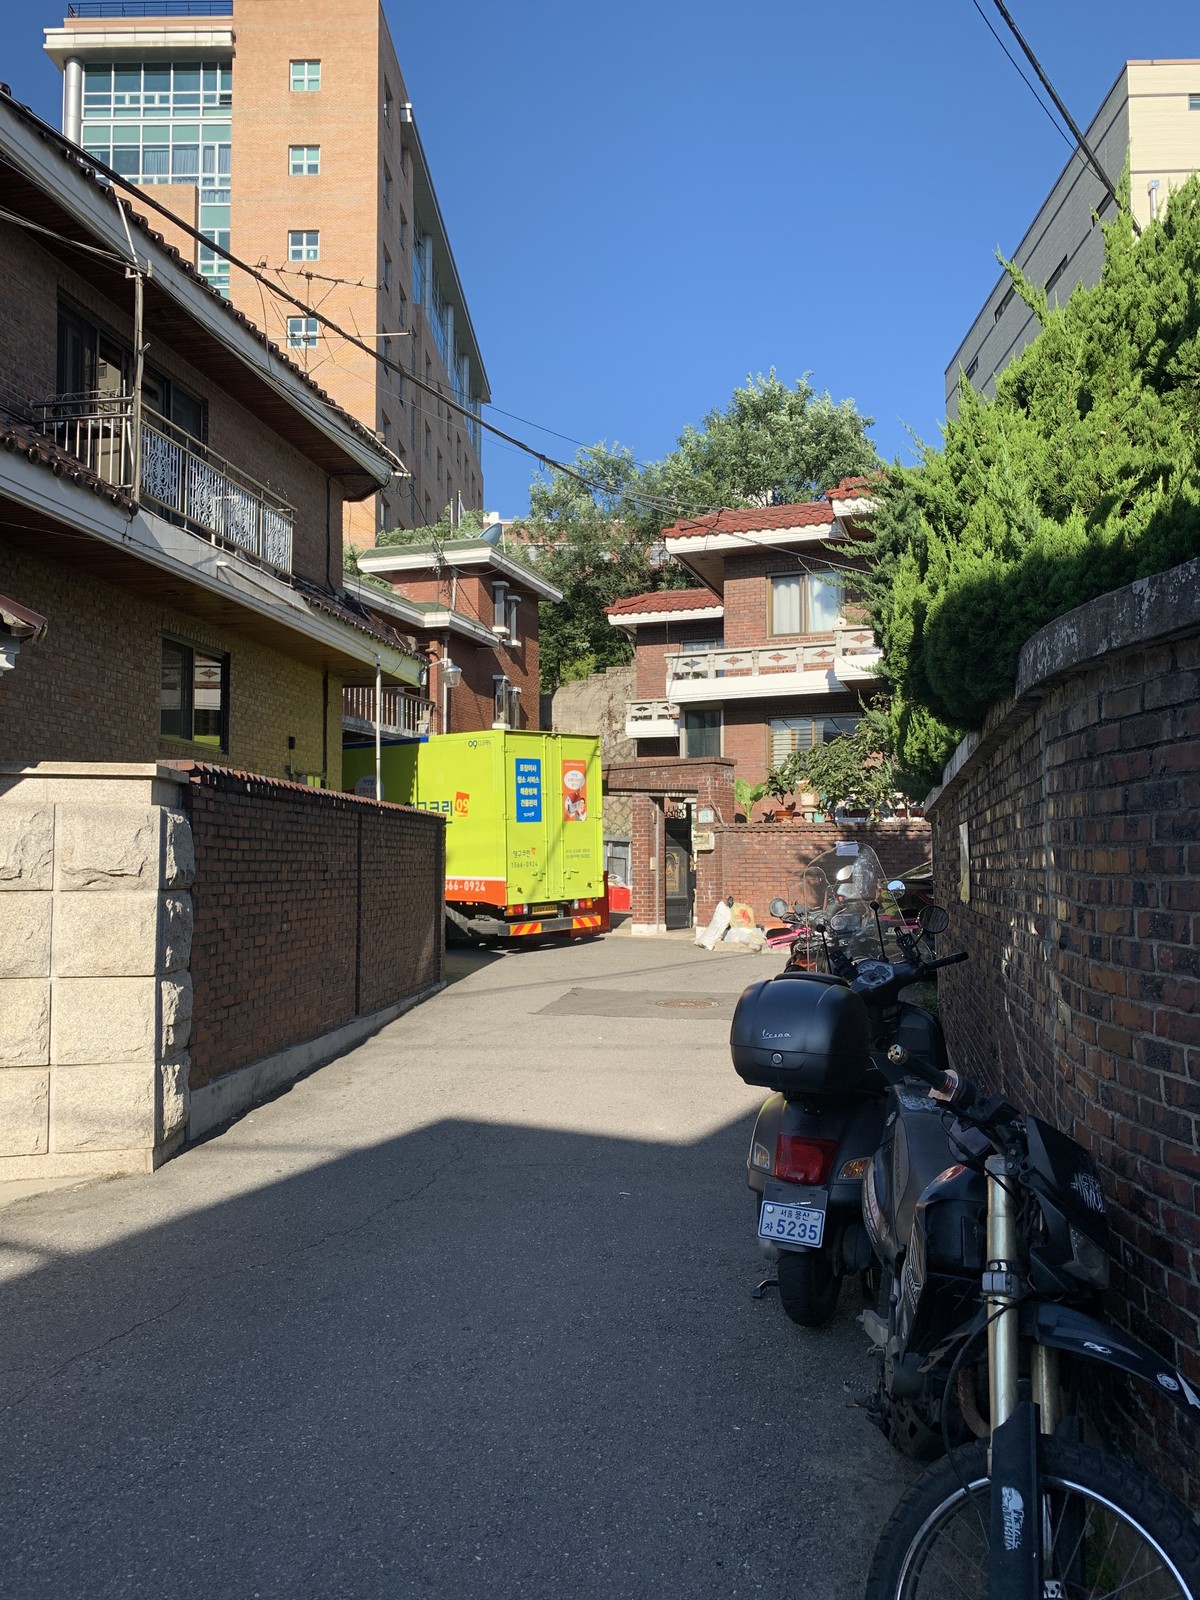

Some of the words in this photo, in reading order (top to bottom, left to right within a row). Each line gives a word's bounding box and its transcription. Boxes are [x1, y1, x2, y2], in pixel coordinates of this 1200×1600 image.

[780, 1209, 793, 1218] 서울
[795, 1210, 810, 1222] 용산
[776, 1218, 818, 1240] 5235
